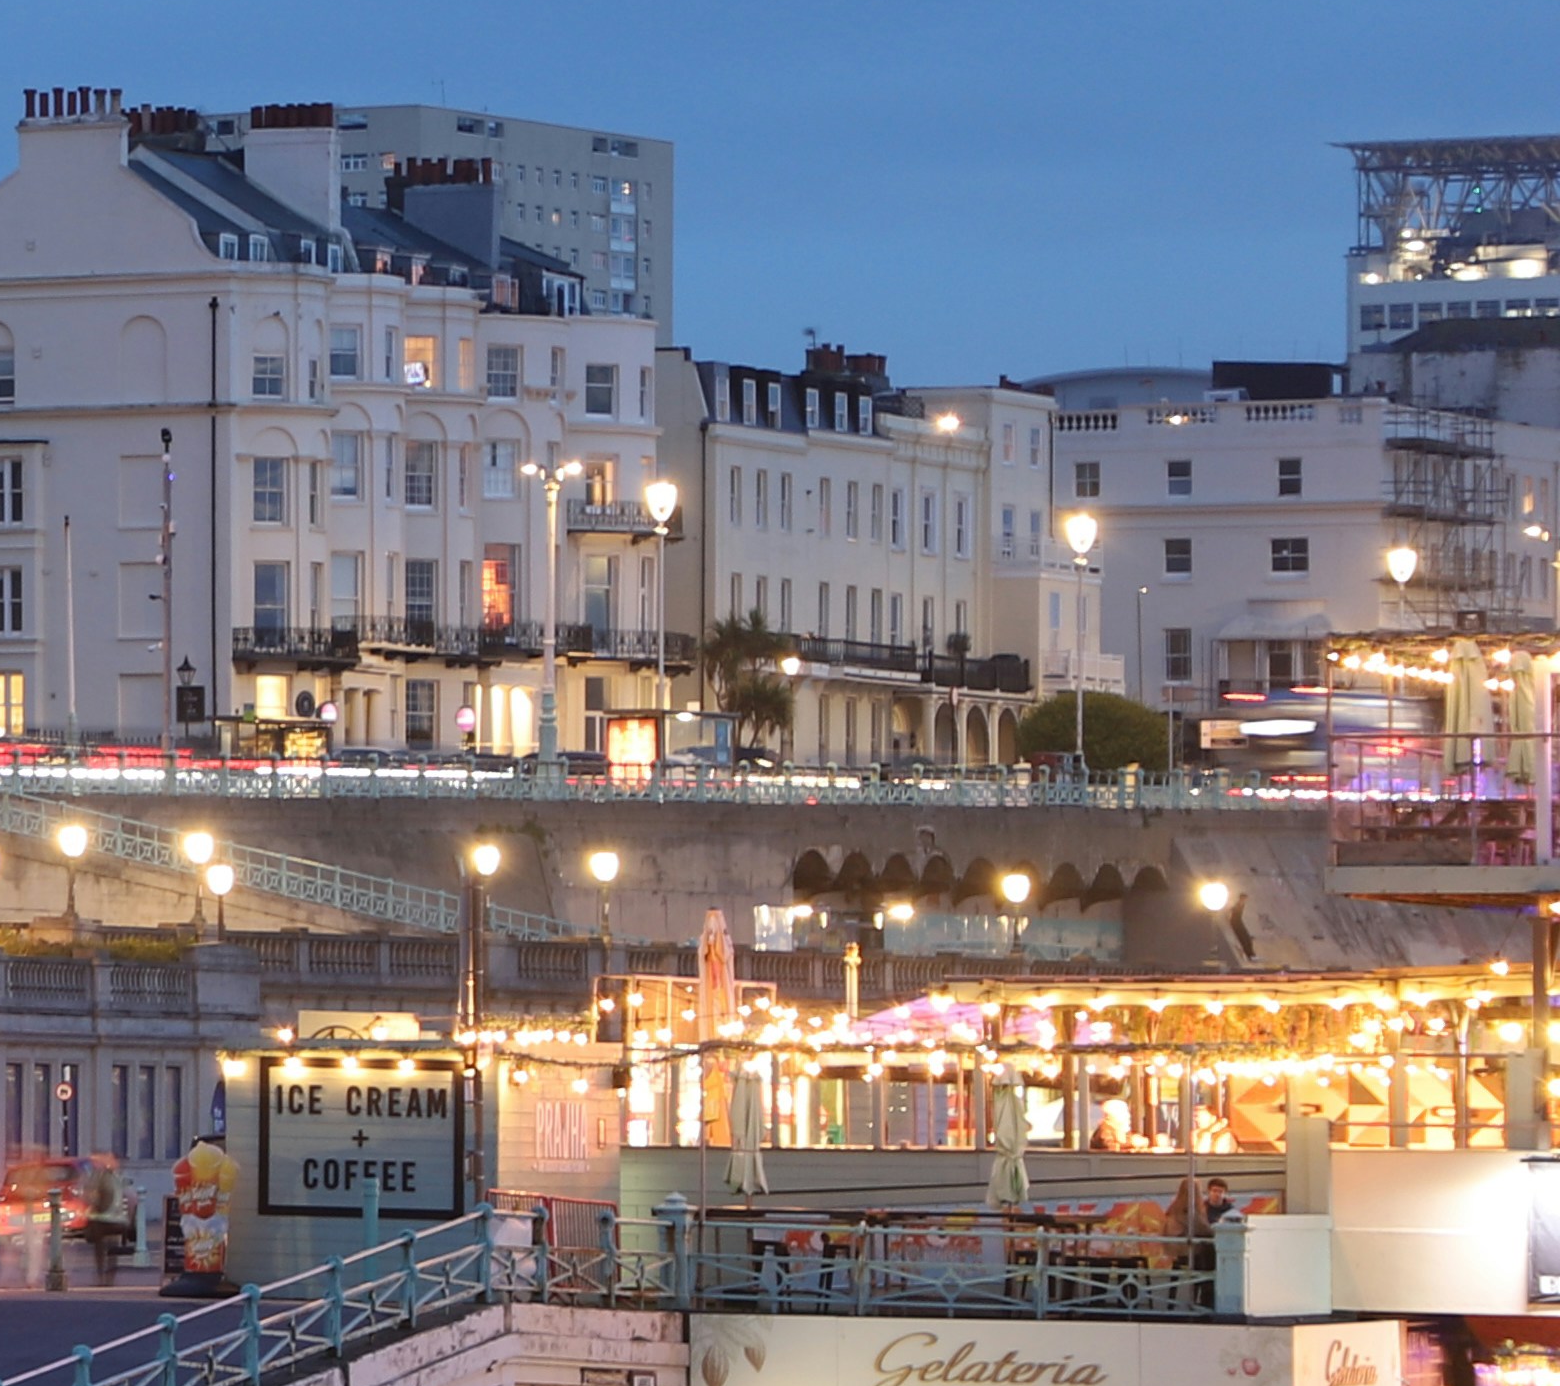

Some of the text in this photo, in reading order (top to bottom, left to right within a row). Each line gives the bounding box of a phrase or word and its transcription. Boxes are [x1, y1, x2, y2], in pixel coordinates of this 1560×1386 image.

[276, 1085, 447, 1119] ICE CREAM
[303, 1158, 416, 1192] COFFEE
